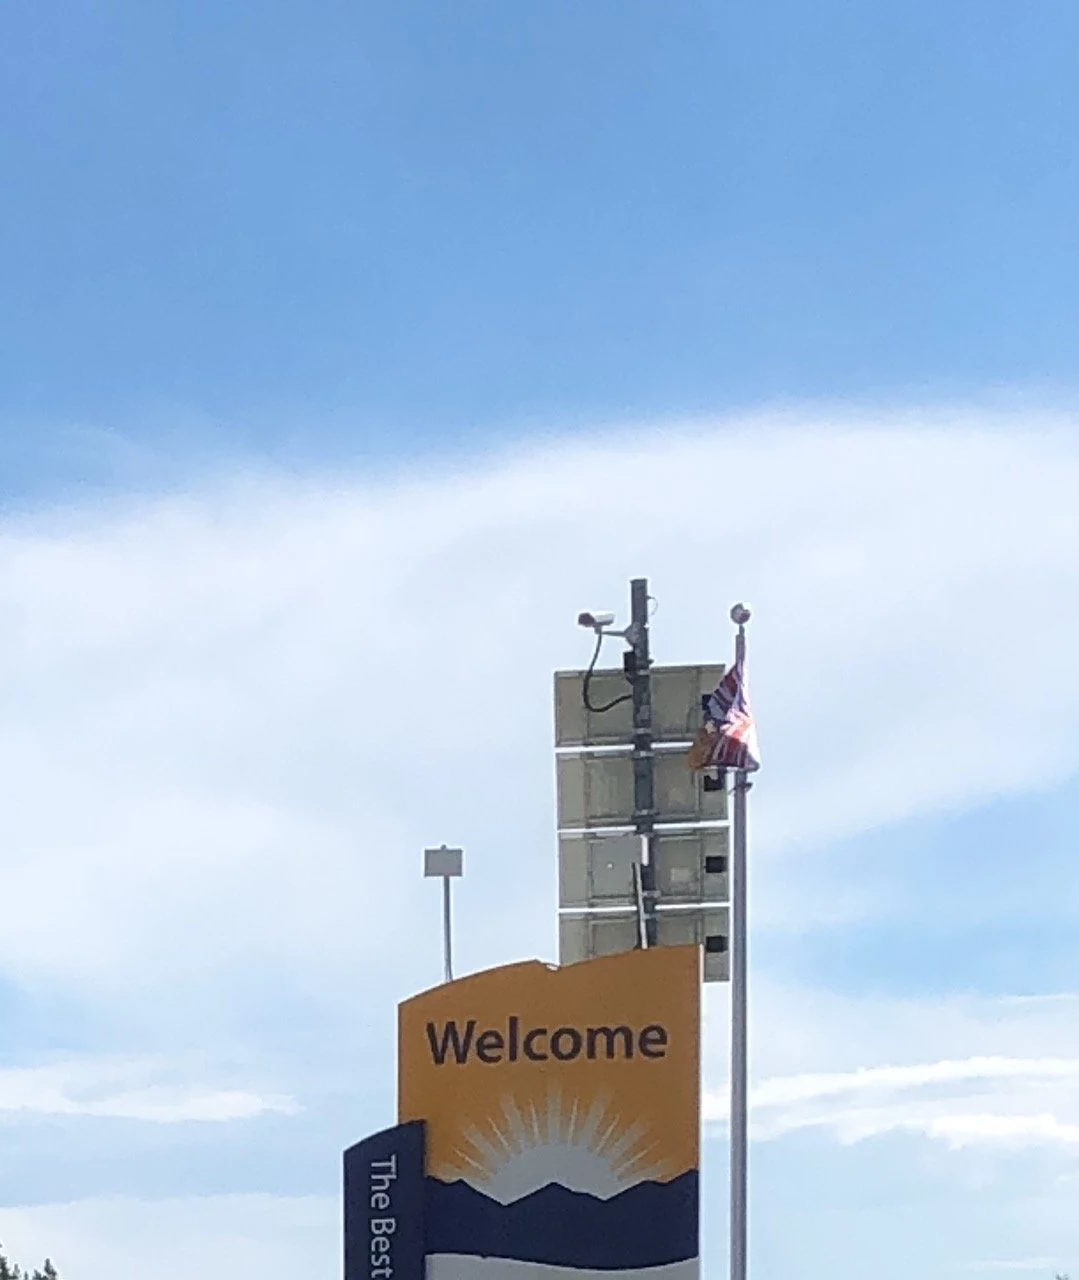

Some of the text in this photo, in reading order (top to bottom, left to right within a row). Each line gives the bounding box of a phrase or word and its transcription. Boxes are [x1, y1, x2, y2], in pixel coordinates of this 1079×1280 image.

[425, 1015, 668, 1066] Welcome
[370, 1153, 397, 1210] The
[370, 1217, 397, 1279] Best
